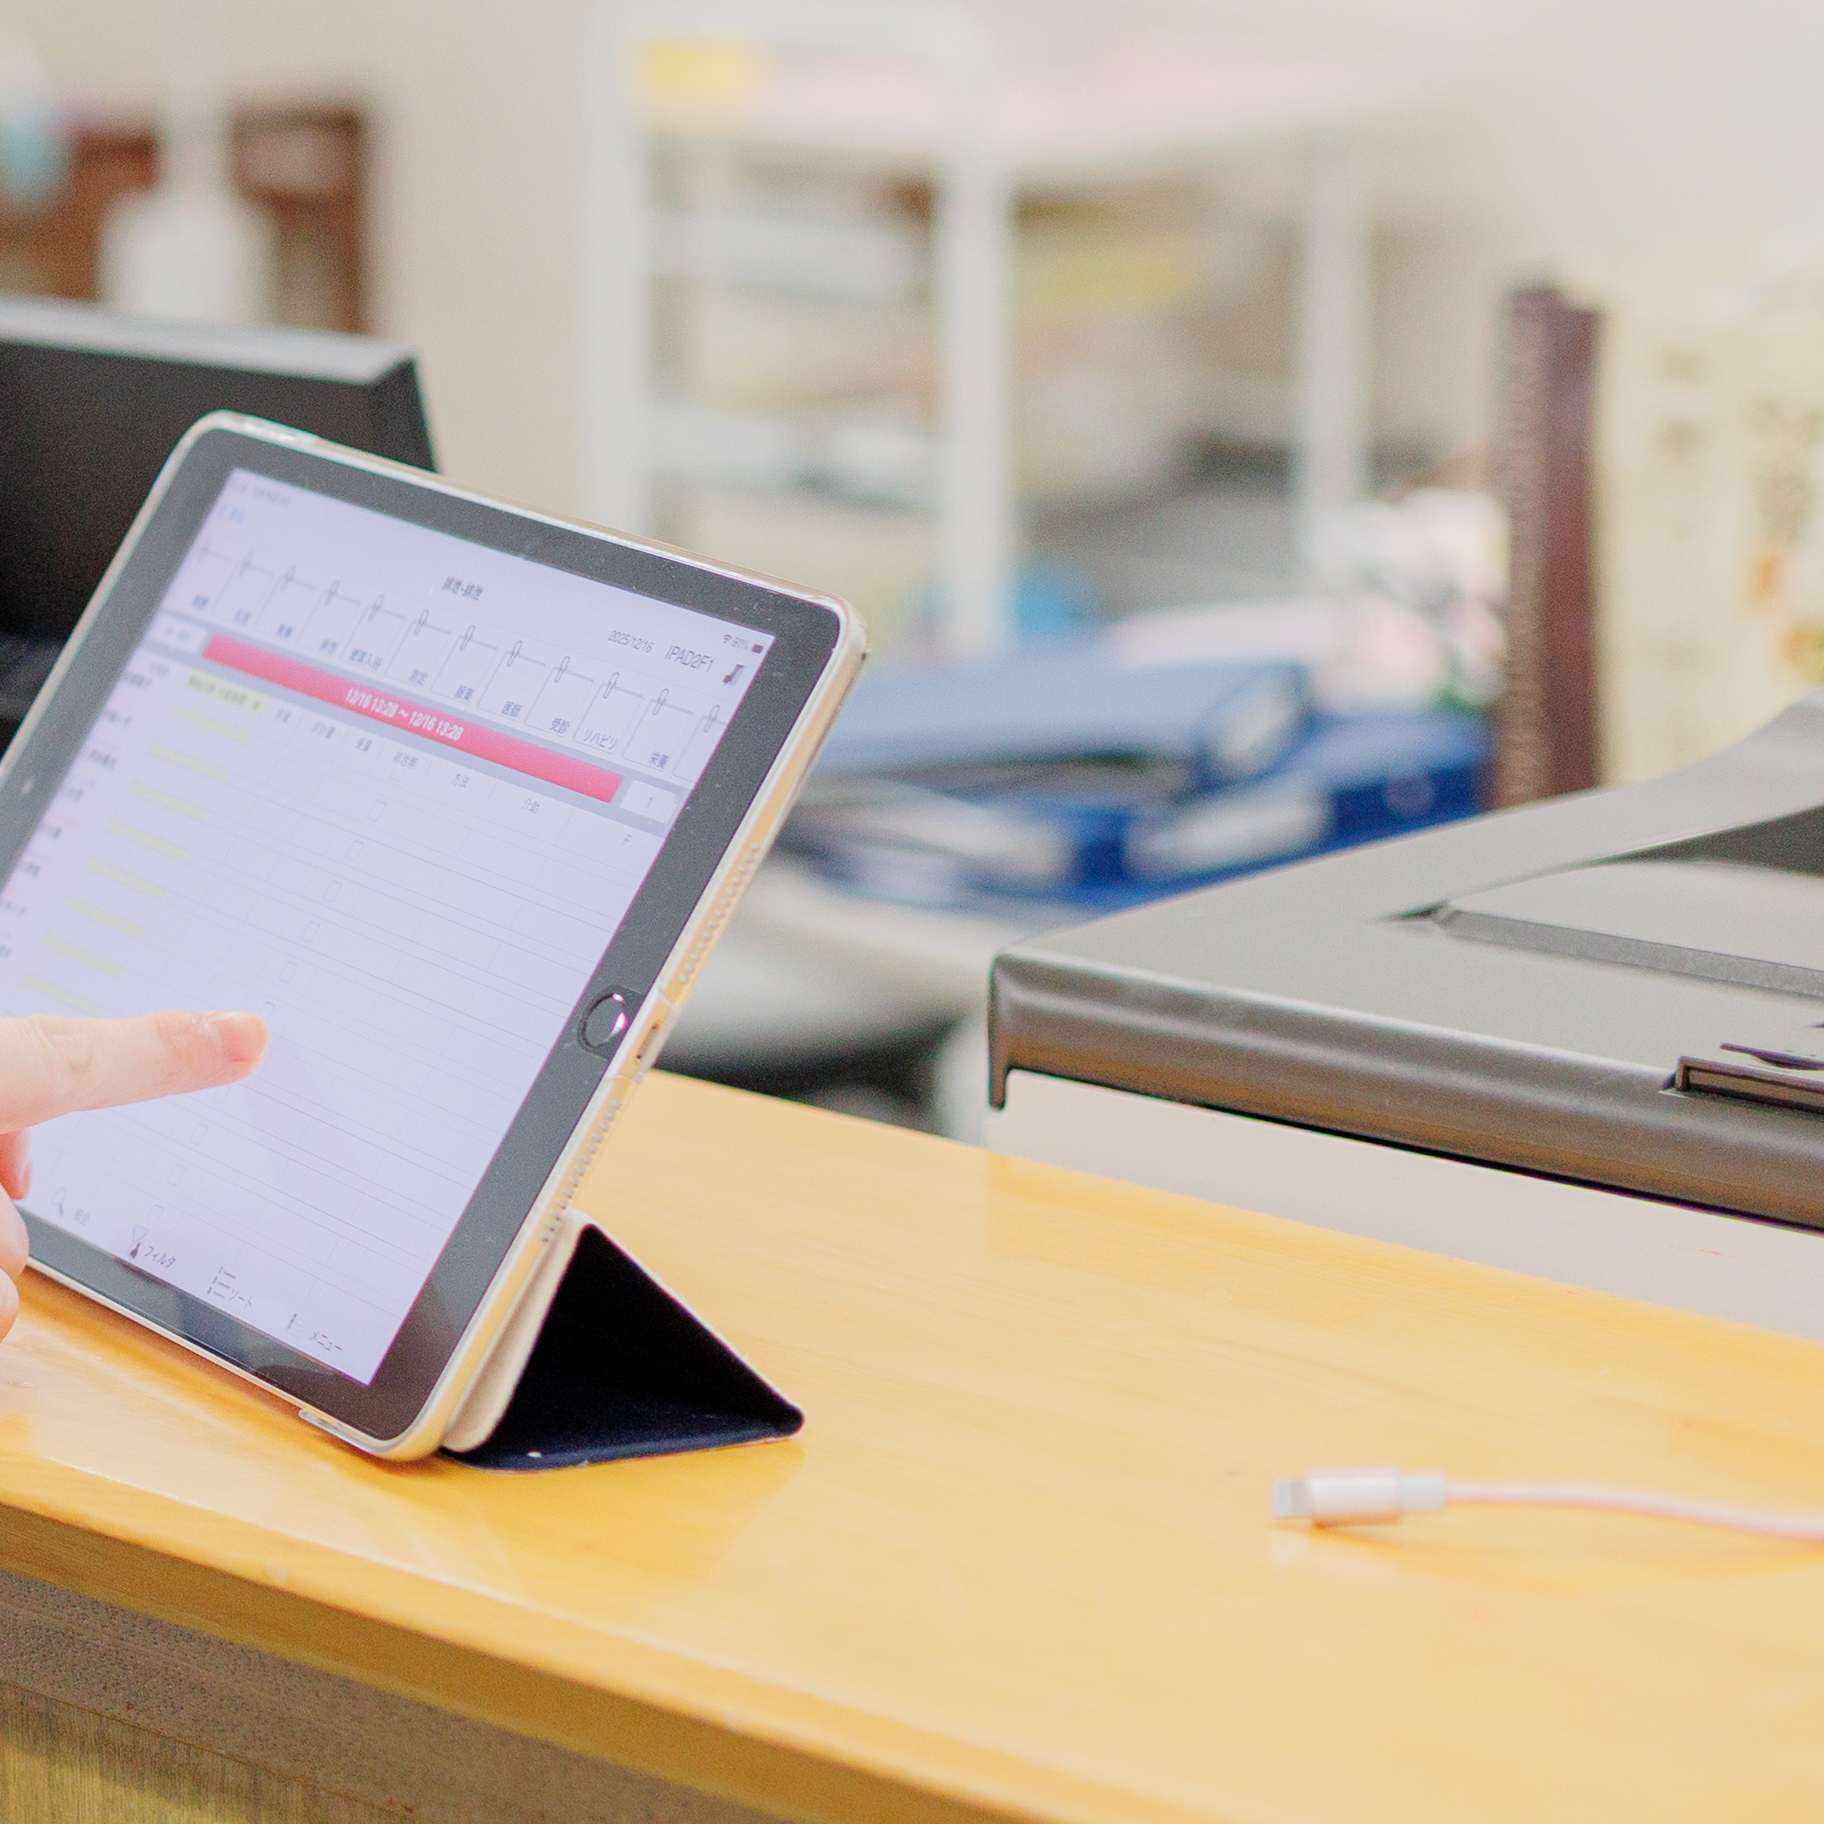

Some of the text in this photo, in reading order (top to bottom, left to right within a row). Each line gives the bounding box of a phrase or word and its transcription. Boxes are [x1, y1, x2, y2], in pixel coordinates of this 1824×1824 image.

[608, 629, 653, 653] 2025/12/16
[665, 646, 714, 673] IPAD2F1
[344, 689, 371, 709] 12/16
[368, 697, 397, 718] 13:28
[407, 711, 437, 732] 12/16
[434, 720, 464, 741] 13:28
[501, 701, 521, 717] 医師
[549, 717, 570, 734] 受診
[581, 728, 618, 750] リハビリ
[648, 751, 669, 768] 栄養
[143, 1244, 175, 1270] フィルタ
[227, 1288, 254, 1310] ソート
[308, 1329, 344, 1356] メニュー
